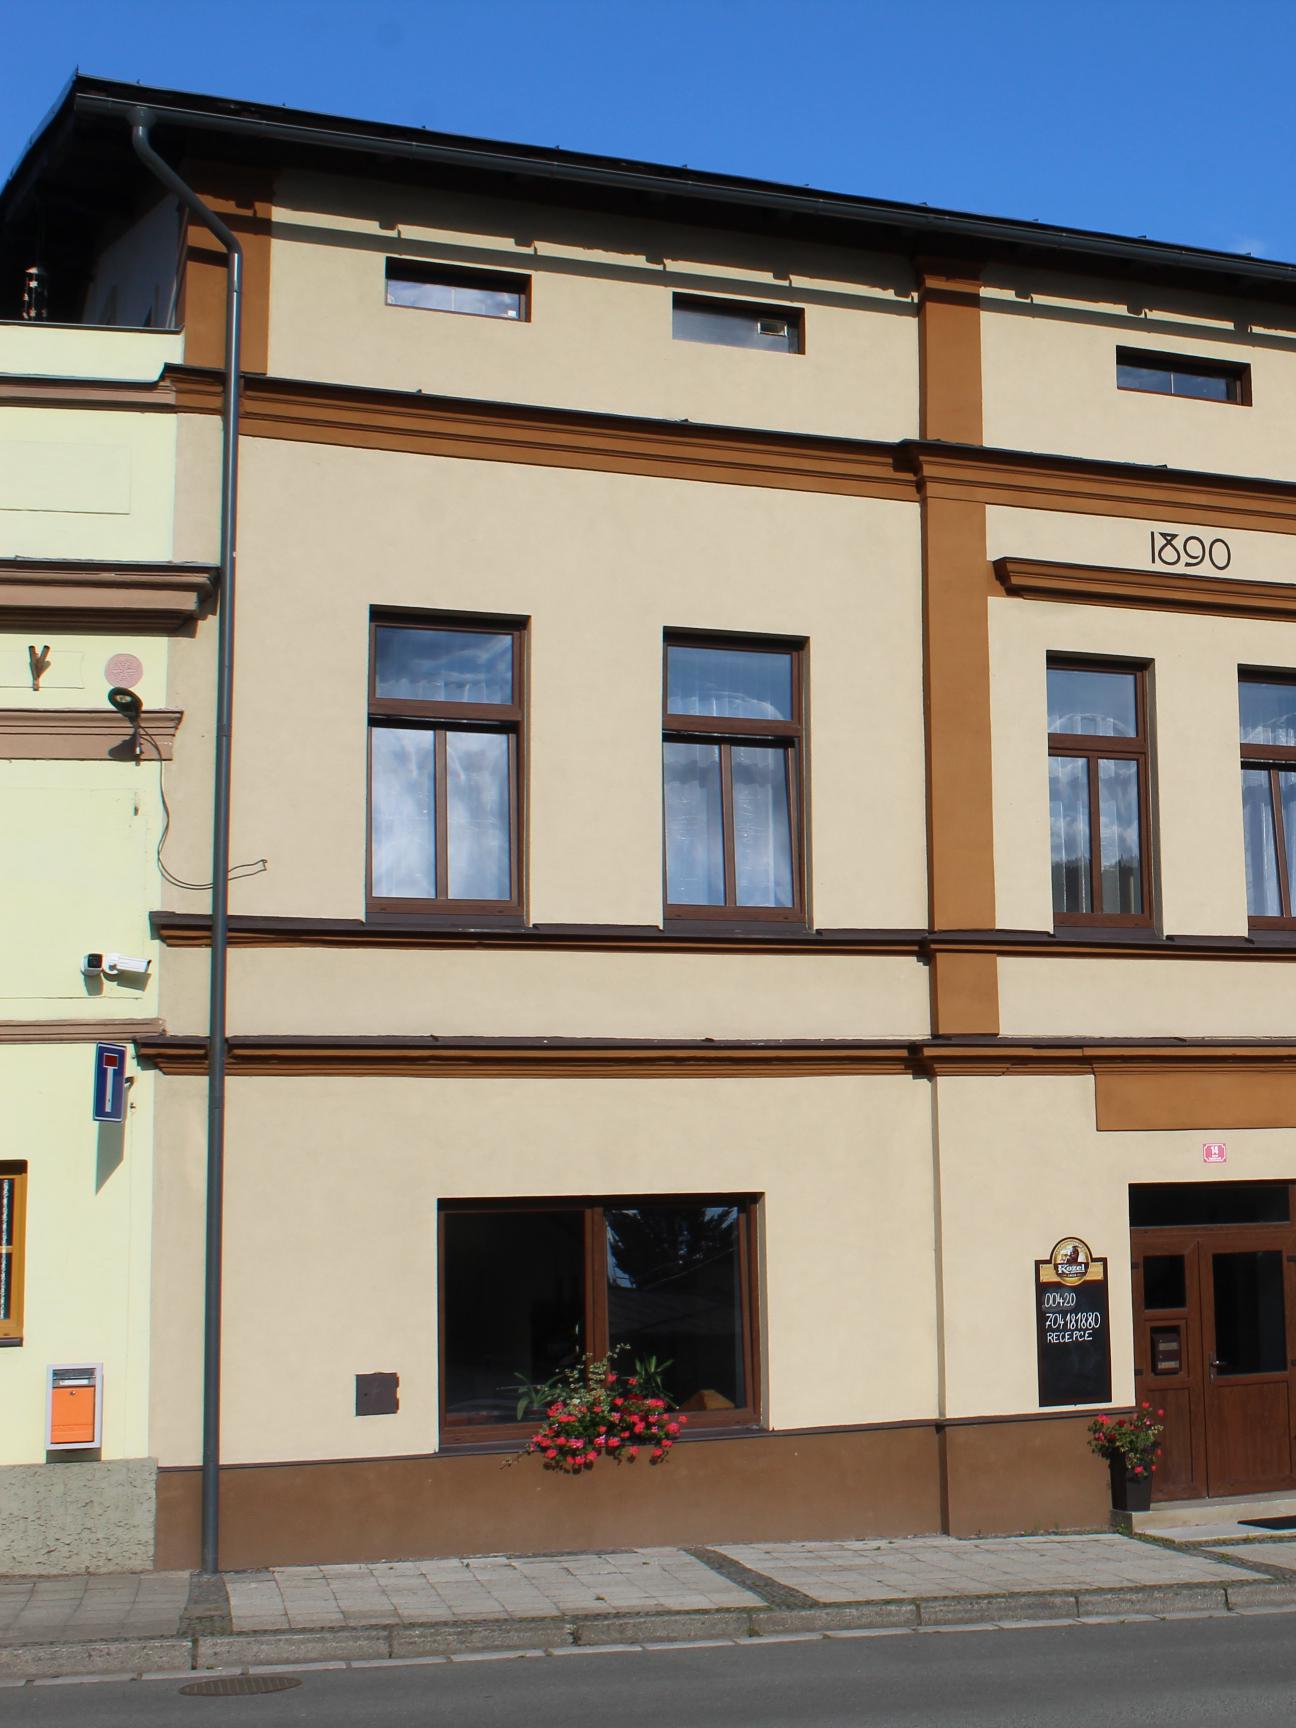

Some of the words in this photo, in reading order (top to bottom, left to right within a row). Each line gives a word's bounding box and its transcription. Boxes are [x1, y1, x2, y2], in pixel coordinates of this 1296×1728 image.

[1150, 531, 1231, 570] 1890
[1057, 1263, 1086, 1274] Kozel
[1045, 1292, 1076, 1307] 00420
[1047, 1330, 1093, 1343] RECEPCE
